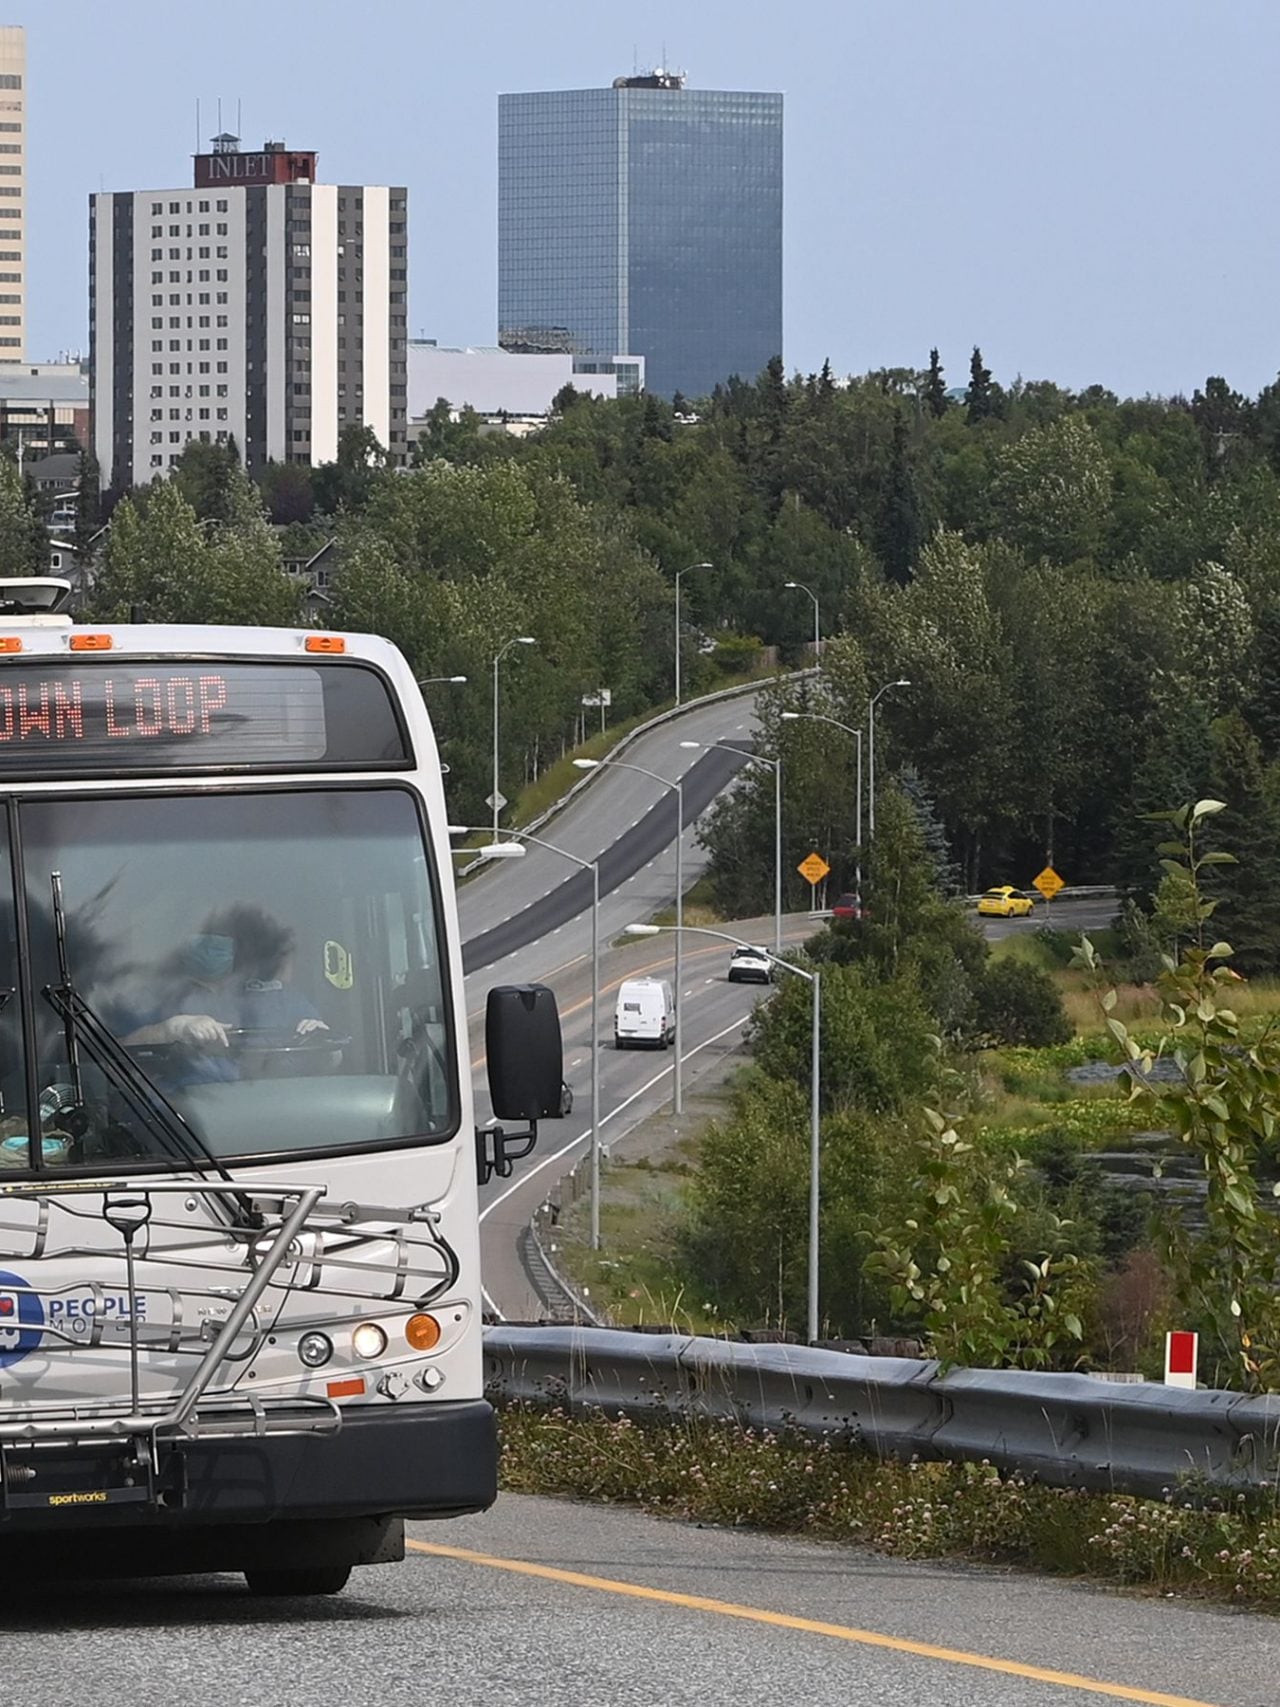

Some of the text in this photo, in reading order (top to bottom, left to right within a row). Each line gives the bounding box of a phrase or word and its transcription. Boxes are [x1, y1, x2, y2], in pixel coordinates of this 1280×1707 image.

[208, 155, 270, 179] INLET
[104, 676, 227, 737] LOOP
[49, 1296, 147, 1318] PEOPLE
[49, 1492, 107, 1505] sportworks
